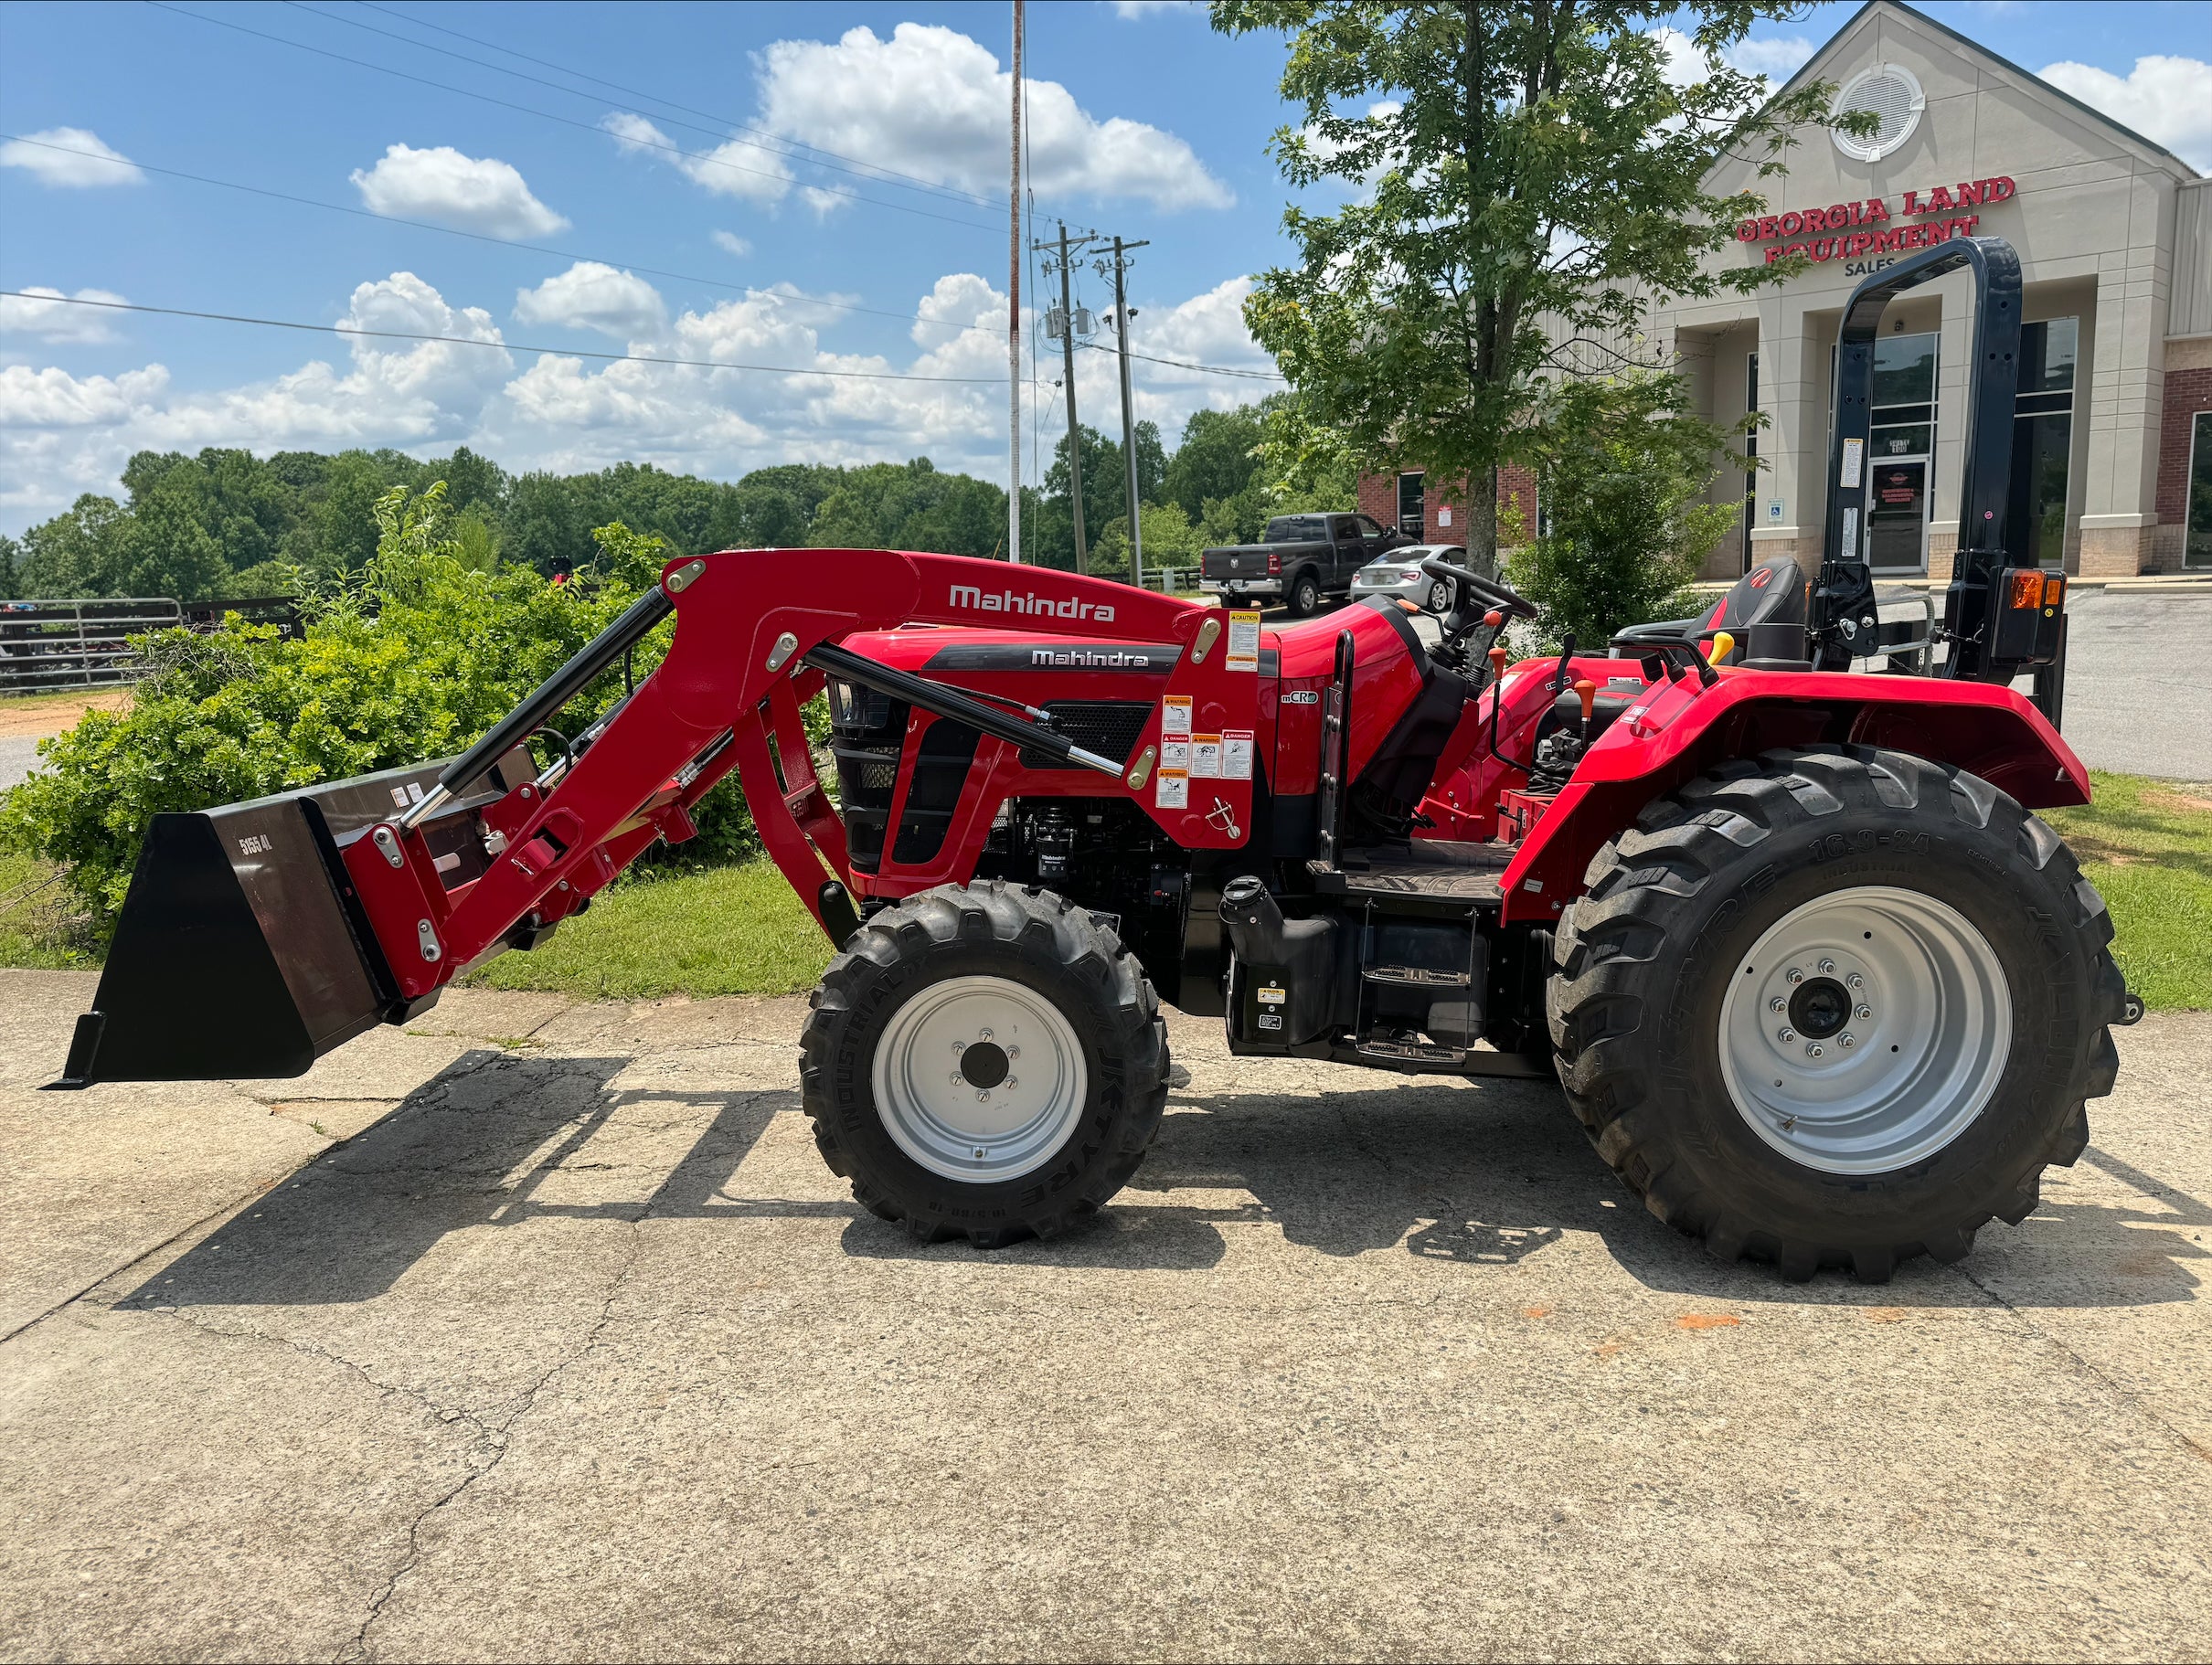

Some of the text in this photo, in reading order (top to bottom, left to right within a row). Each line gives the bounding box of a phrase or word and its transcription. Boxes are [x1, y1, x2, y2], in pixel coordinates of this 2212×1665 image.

[1736, 175, 2015, 243] GEORGIA LAND
[949, 585, 1115, 622] Mahindra
[1031, 650, 1149, 667] Mahindra
[239, 836, 262, 855] 5155
[837, 973, 904, 1133] INDUSTRIAL
